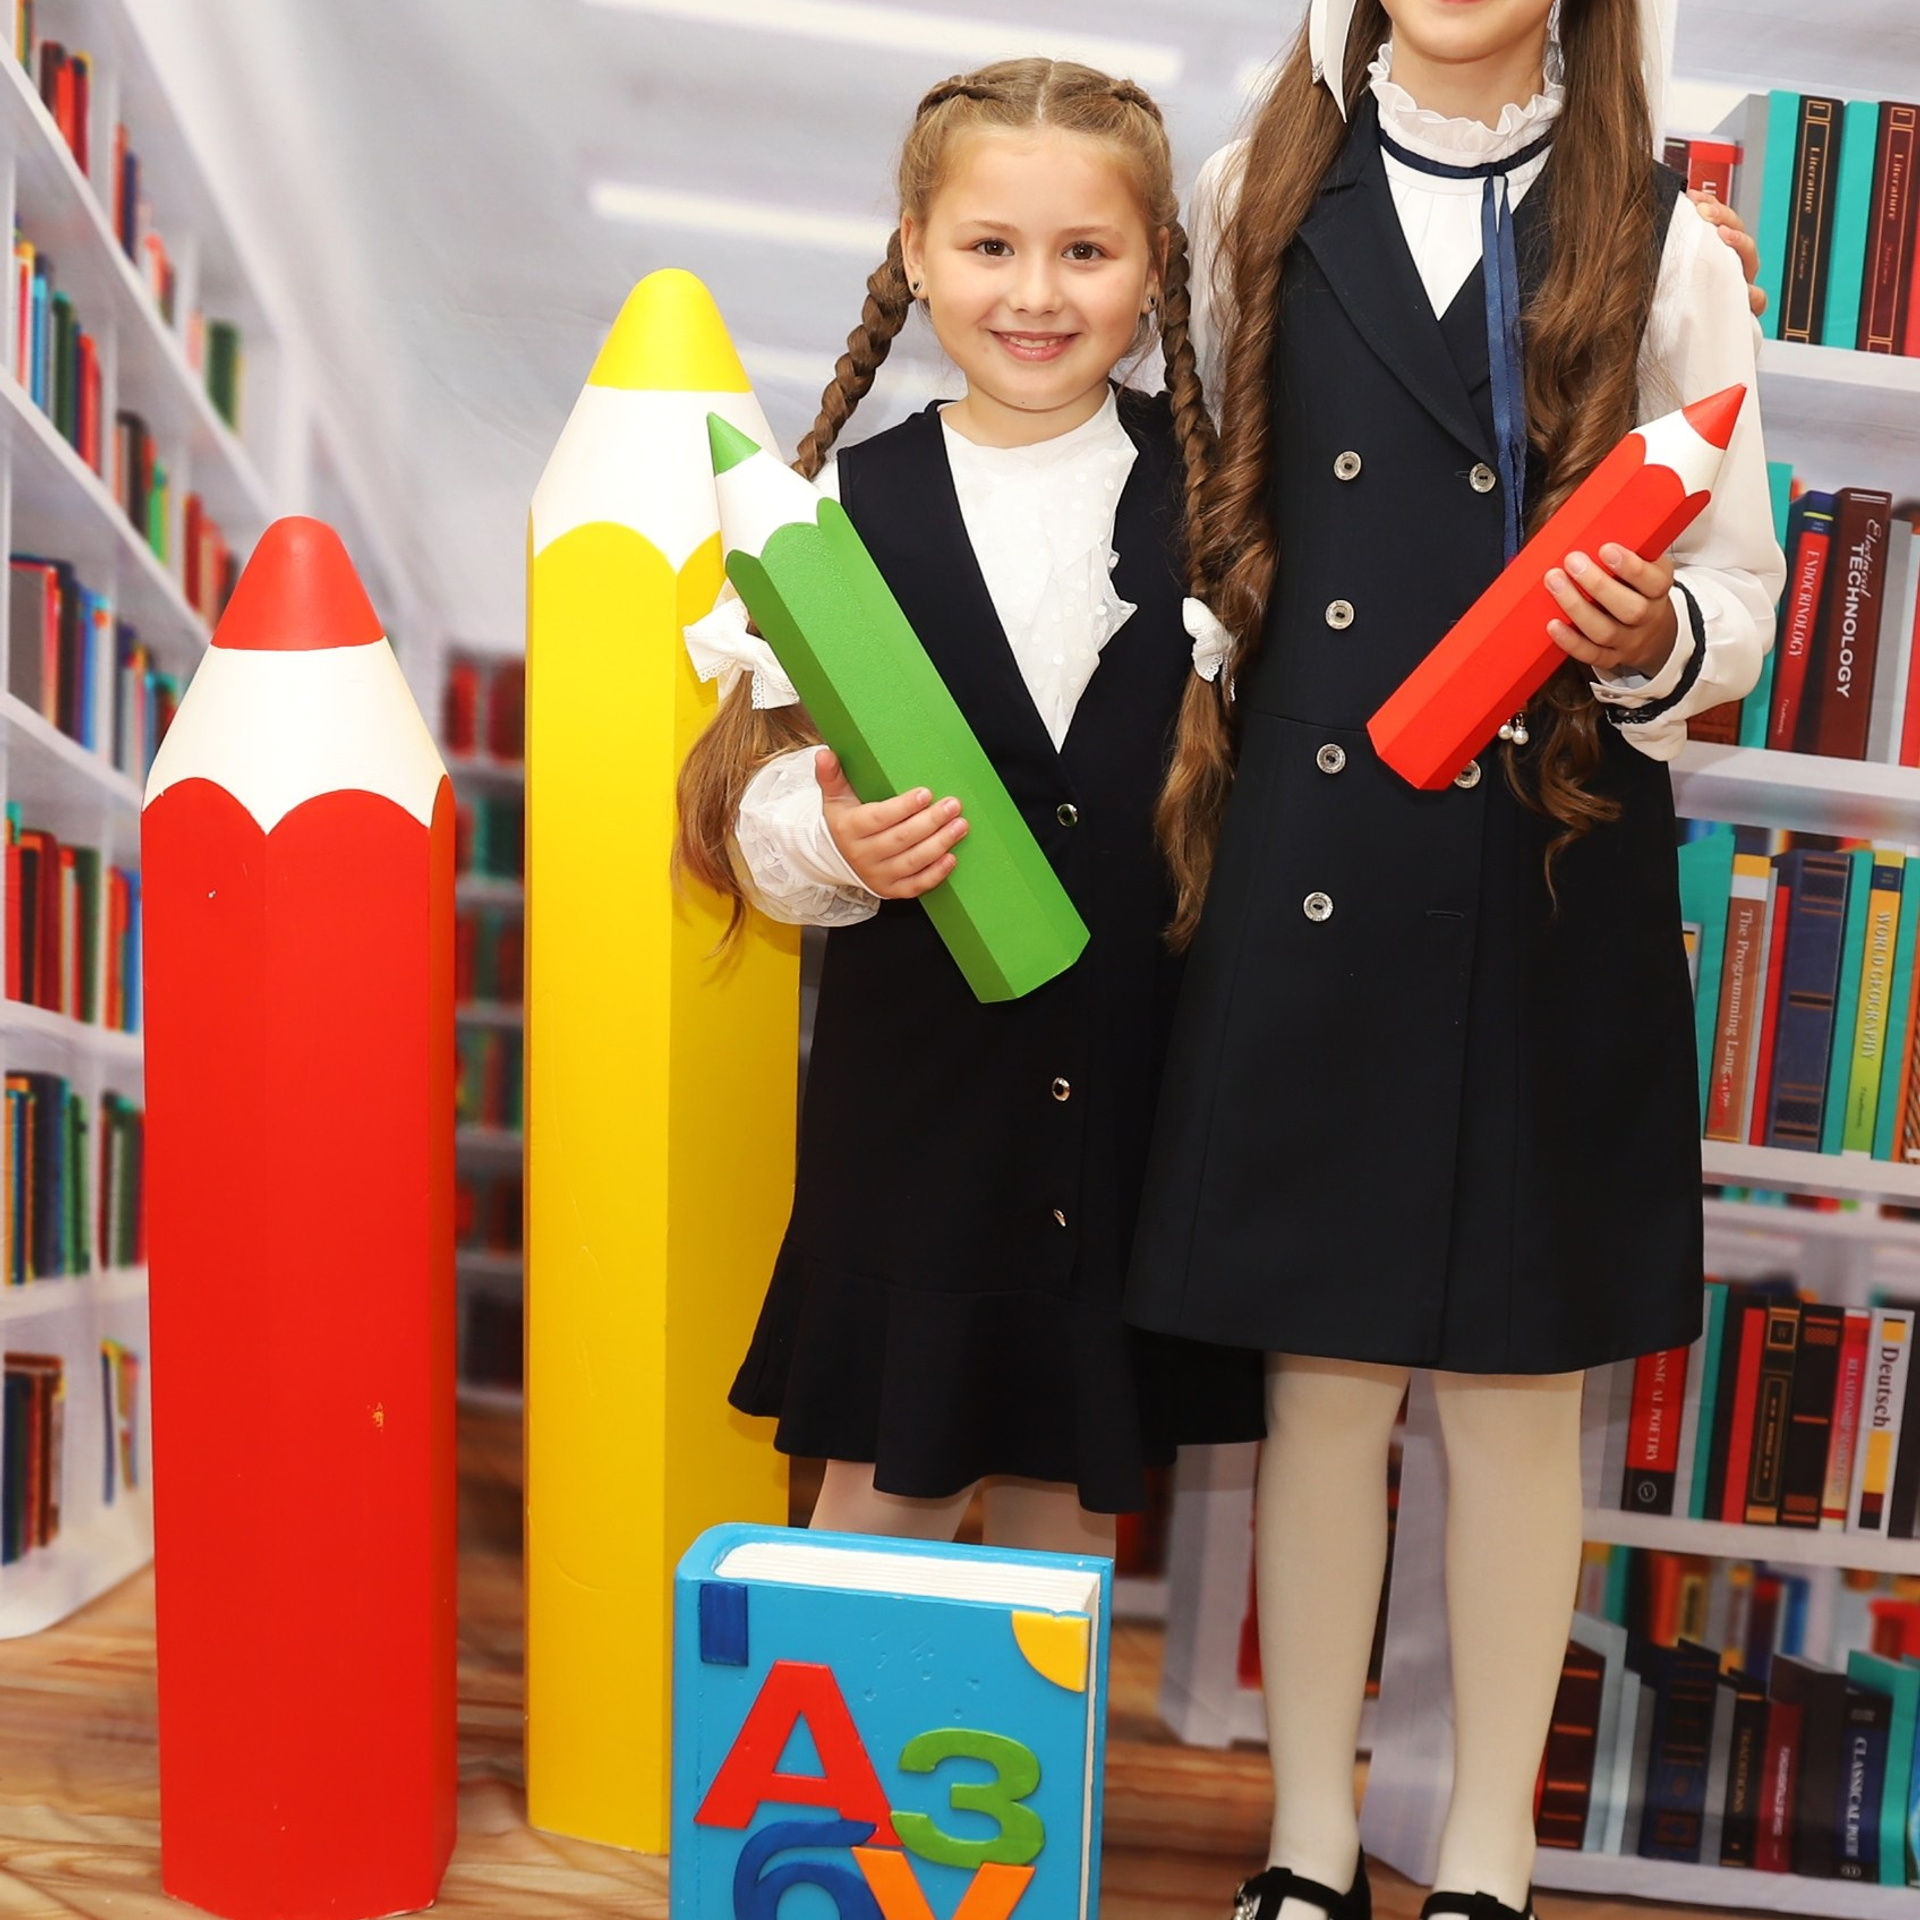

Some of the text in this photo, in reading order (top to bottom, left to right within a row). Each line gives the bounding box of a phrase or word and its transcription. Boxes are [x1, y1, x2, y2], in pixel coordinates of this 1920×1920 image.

[1804, 147, 1820, 214] Literature
[1888, 153, 1904, 221] Literature
[1859, 518, 1882, 598] Electrical
[1789, 550, 1820, 658] ENDOCRINOLOGY
[1836, 543, 1865, 699] TECHNOLOGY
[1738, 909, 1754, 937] The
[1725, 940, 1750, 1037] Programming
[1862, 911, 1892, 1060] WORLD GEOGRAPHY
[1872, 1347, 1899, 1428] Deutsch
[1645, 1408, 1662, 1462] POETRY
[1846, 1736, 1868, 1822] CLASSICAL
